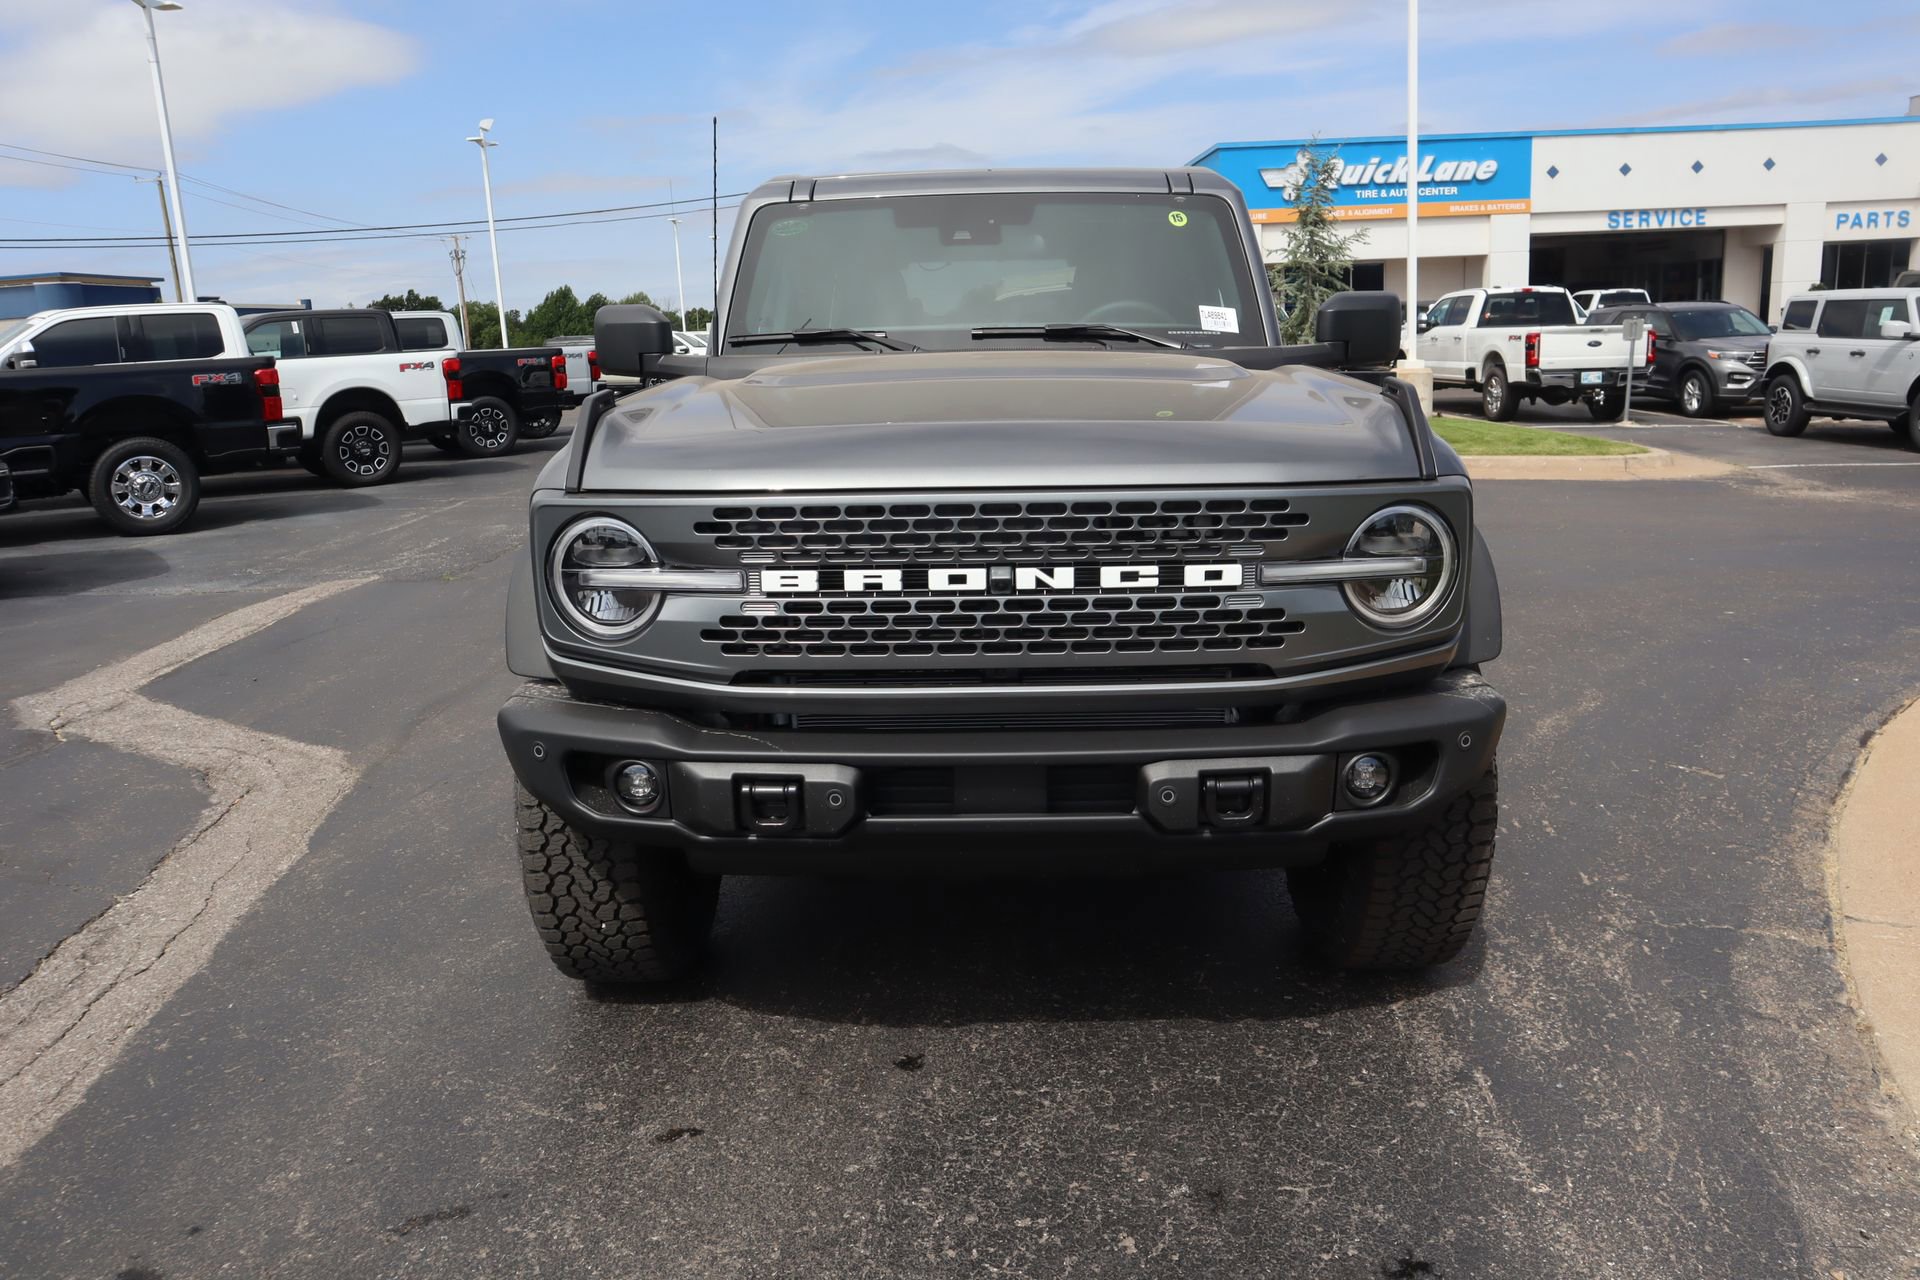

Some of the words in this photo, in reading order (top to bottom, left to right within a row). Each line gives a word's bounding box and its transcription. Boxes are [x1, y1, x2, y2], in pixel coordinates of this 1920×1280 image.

[1416, 154, 1498, 183] Lane
[1355, 189, 1378, 199] TIRE
[1381, 188, 1389, 198] &
[1390, 187, 1411, 197] AUT
[1418, 185, 1458, 196] CENTER
[1353, 207, 1393, 216] ALIGNMENT
[1449, 204, 1477, 212] BRAKES
[1487, 202, 1526, 212] BATTERIES
[1171, 213, 1184, 223] 15
[1608, 208, 1708, 229] SERVICE
[1836, 210, 1911, 230] PARTS
[399, 361, 435, 372] FX4
[517, 357, 547, 366] FX4
[191, 372, 242, 386] FX4
[761, 564, 1242, 592] BRONCO
